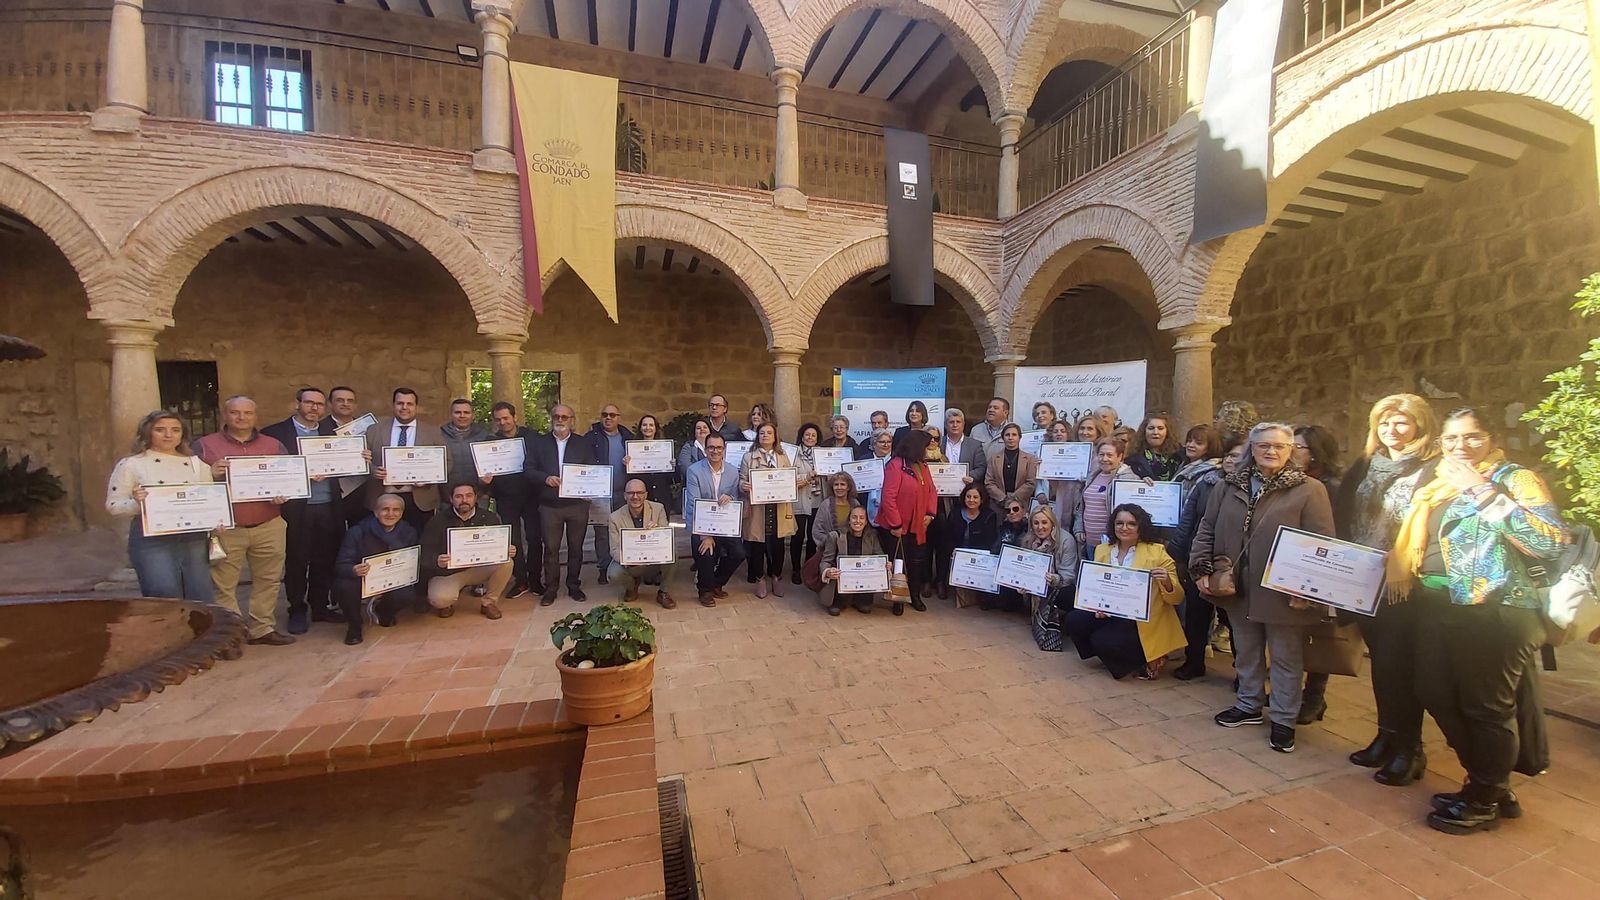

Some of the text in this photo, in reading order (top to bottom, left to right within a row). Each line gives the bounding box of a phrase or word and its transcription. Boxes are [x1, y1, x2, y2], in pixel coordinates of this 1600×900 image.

[532, 153, 578, 168] COMARCA
[532, 162, 590, 180] CONDADO
[1038, 375, 1057, 385] Del
[1057, 374, 1089, 385] Condado
[1047, 388, 1055, 397] la
[1059, 387, 1090, 397] Calidad
[1089, 386, 1121, 397] Rural
